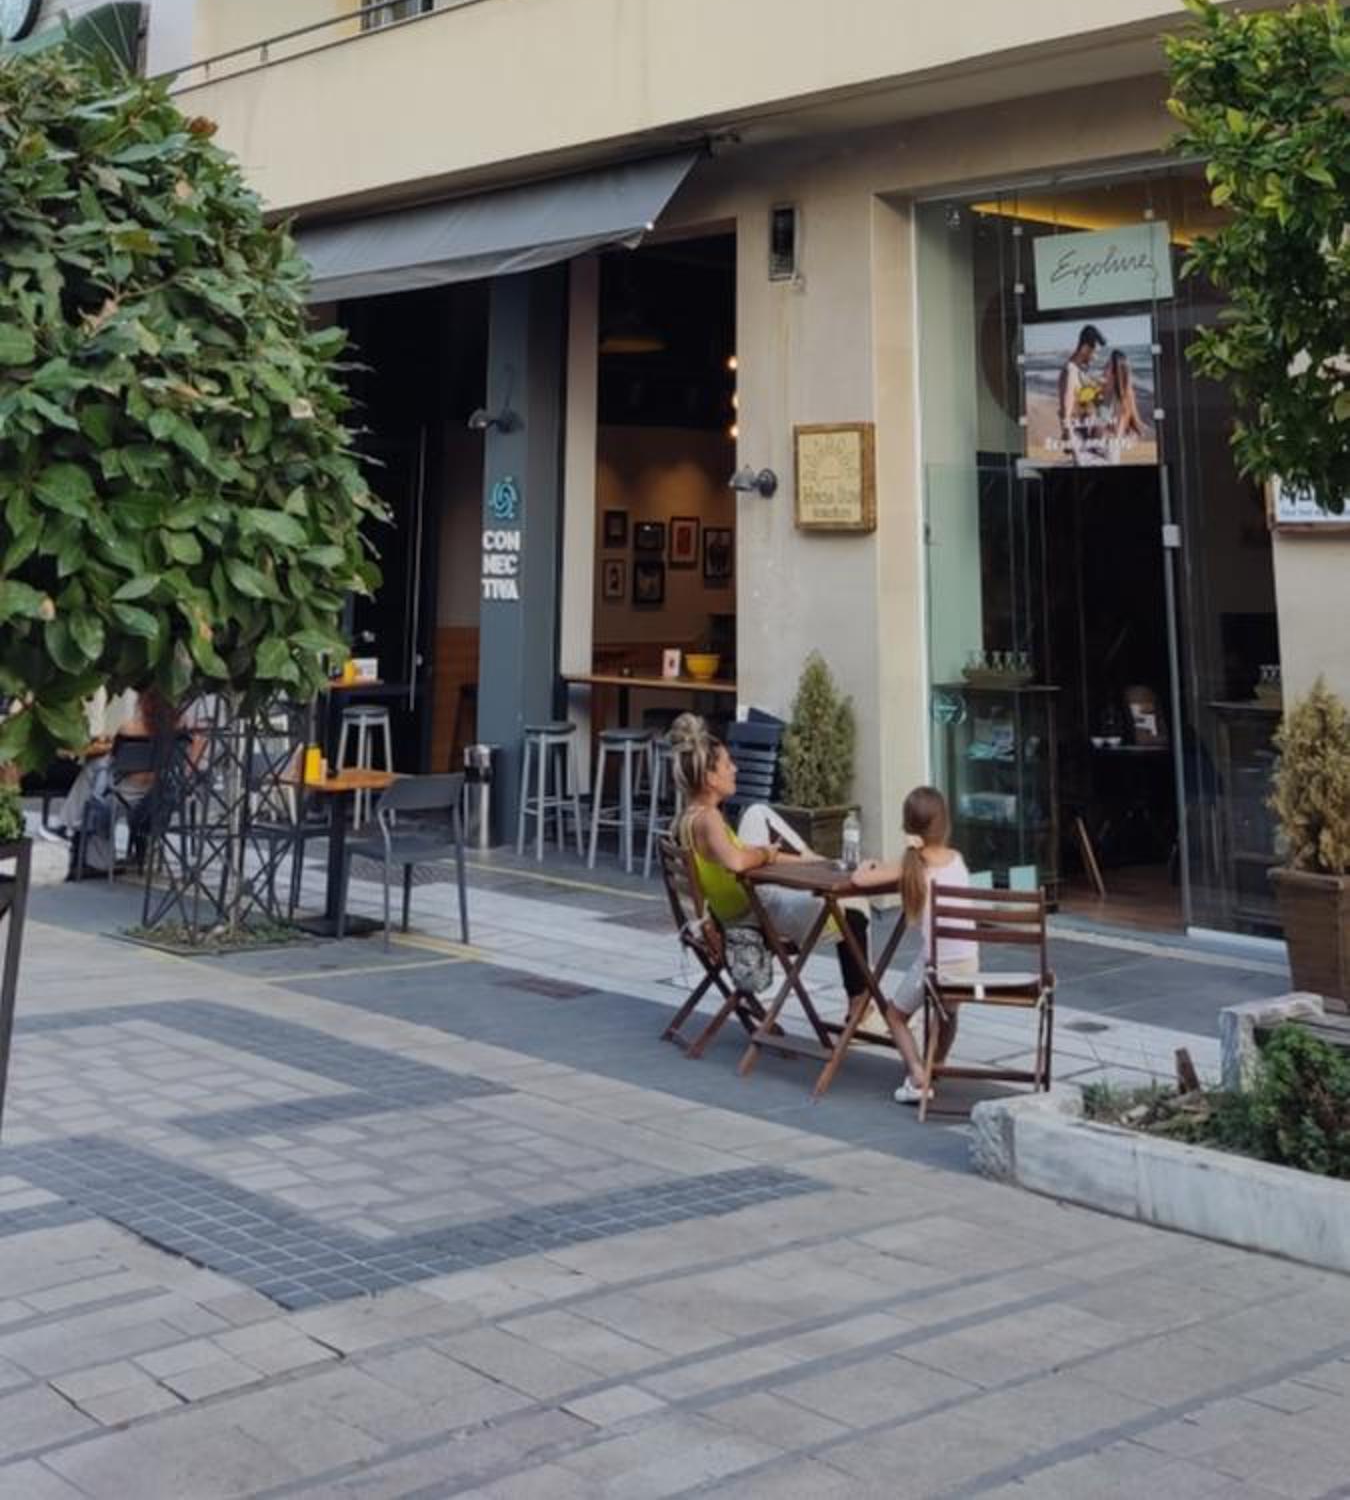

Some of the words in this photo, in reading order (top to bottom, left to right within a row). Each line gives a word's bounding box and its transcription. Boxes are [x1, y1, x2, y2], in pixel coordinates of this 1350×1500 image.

[482, 530, 520, 551] CON
[482, 553, 518, 575] NEC
[481, 577, 519, 600] TIVA
